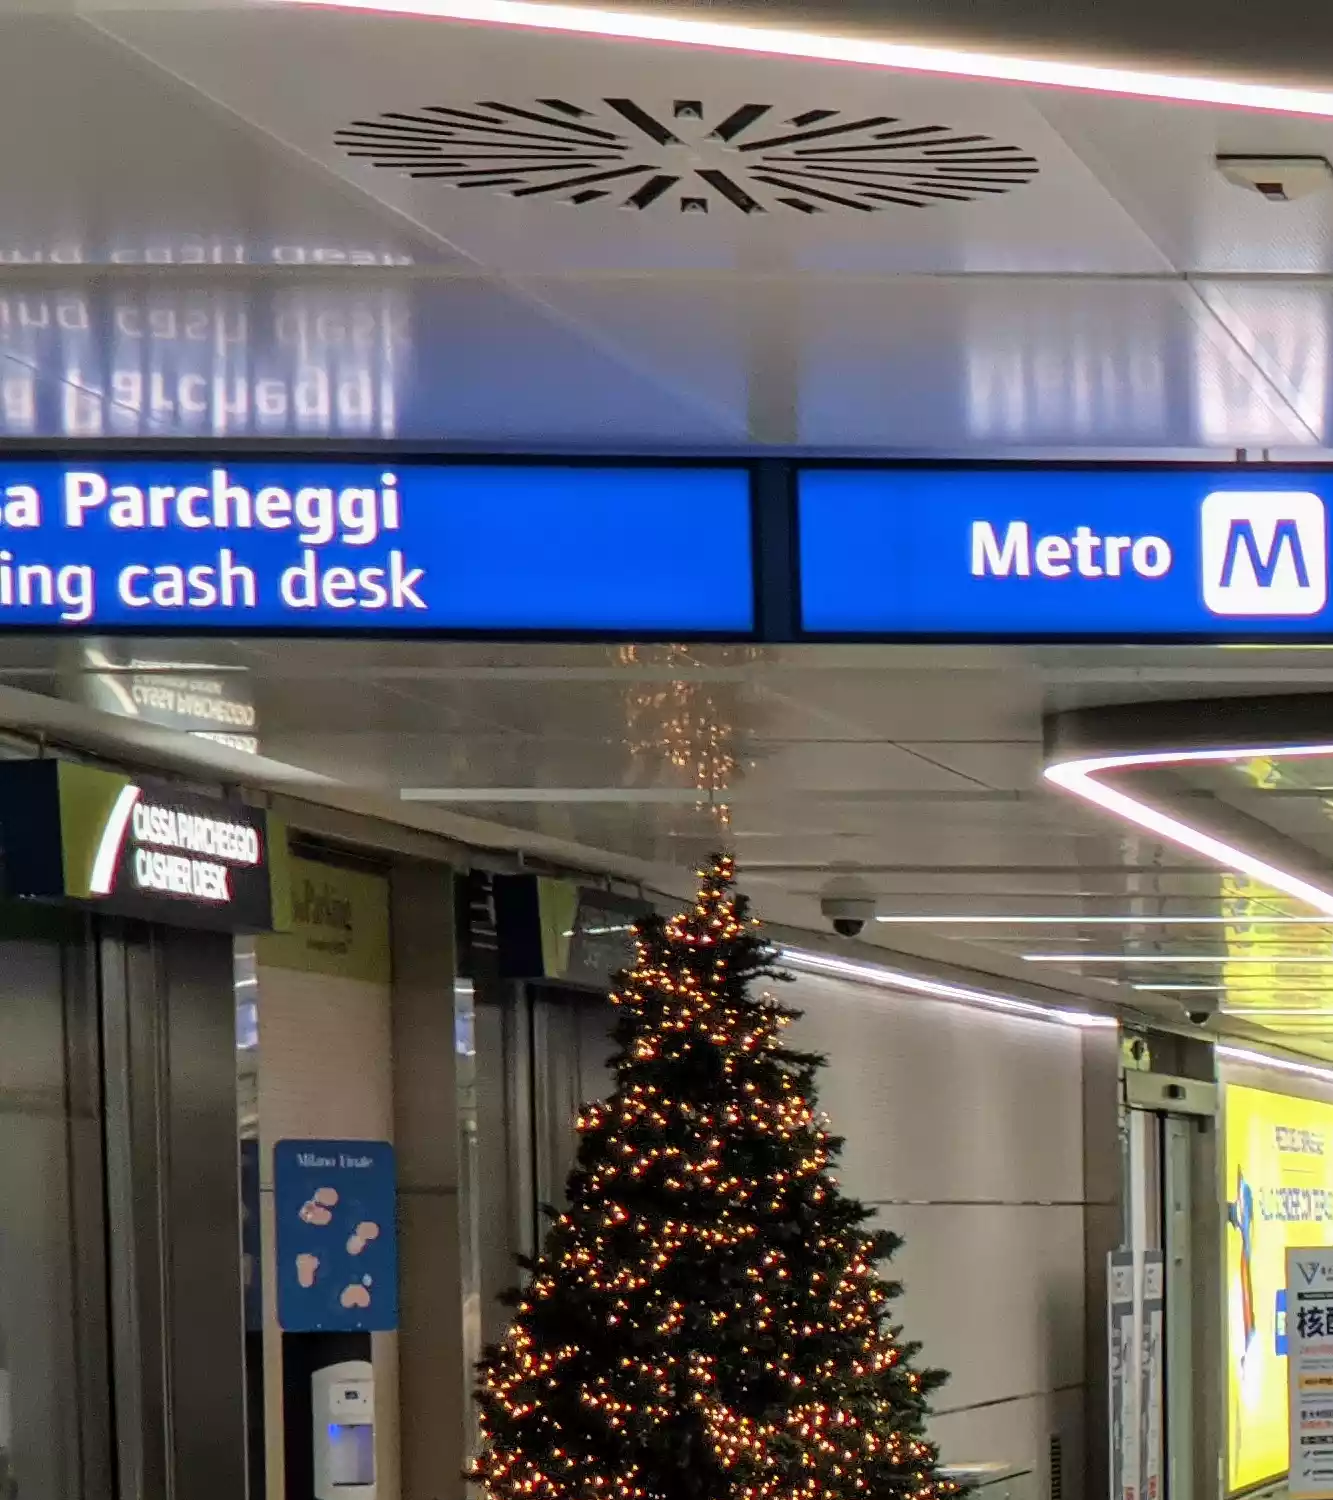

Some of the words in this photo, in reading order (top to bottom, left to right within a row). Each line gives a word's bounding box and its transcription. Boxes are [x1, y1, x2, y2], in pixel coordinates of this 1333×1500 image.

[0, 484, 41, 528] a
[64, 471, 400, 543] Parcheggi
[119, 549, 256, 609] cash
[281, 549, 428, 609] desk
[971, 521, 1173, 577] Metro
[133, 802, 176, 845] CASSA
[176, 812, 260, 865] PARCHEGGIO
[136, 848, 191, 895] CASHIER
[192, 860, 231, 901] DESK
